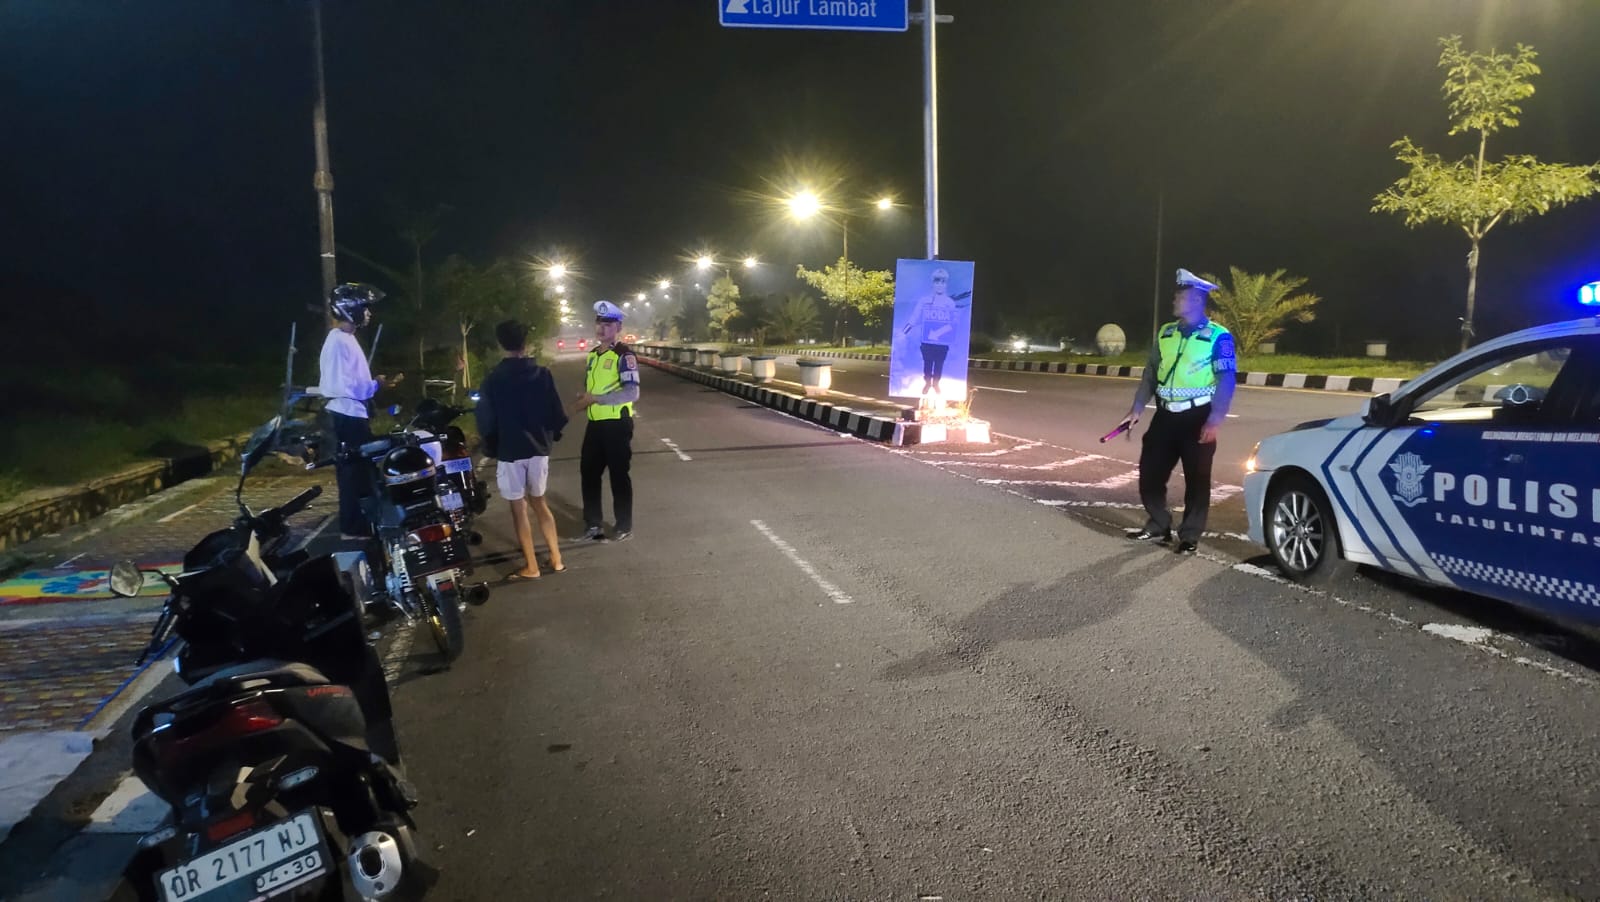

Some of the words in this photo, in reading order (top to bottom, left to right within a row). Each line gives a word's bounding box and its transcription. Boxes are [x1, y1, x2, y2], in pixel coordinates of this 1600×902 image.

[752, 0, 800, 17] Lajur
[809, 0, 877, 17] Lambat
[212, 839, 266, 882] 2177
[277, 823, 307, 853] NJ
